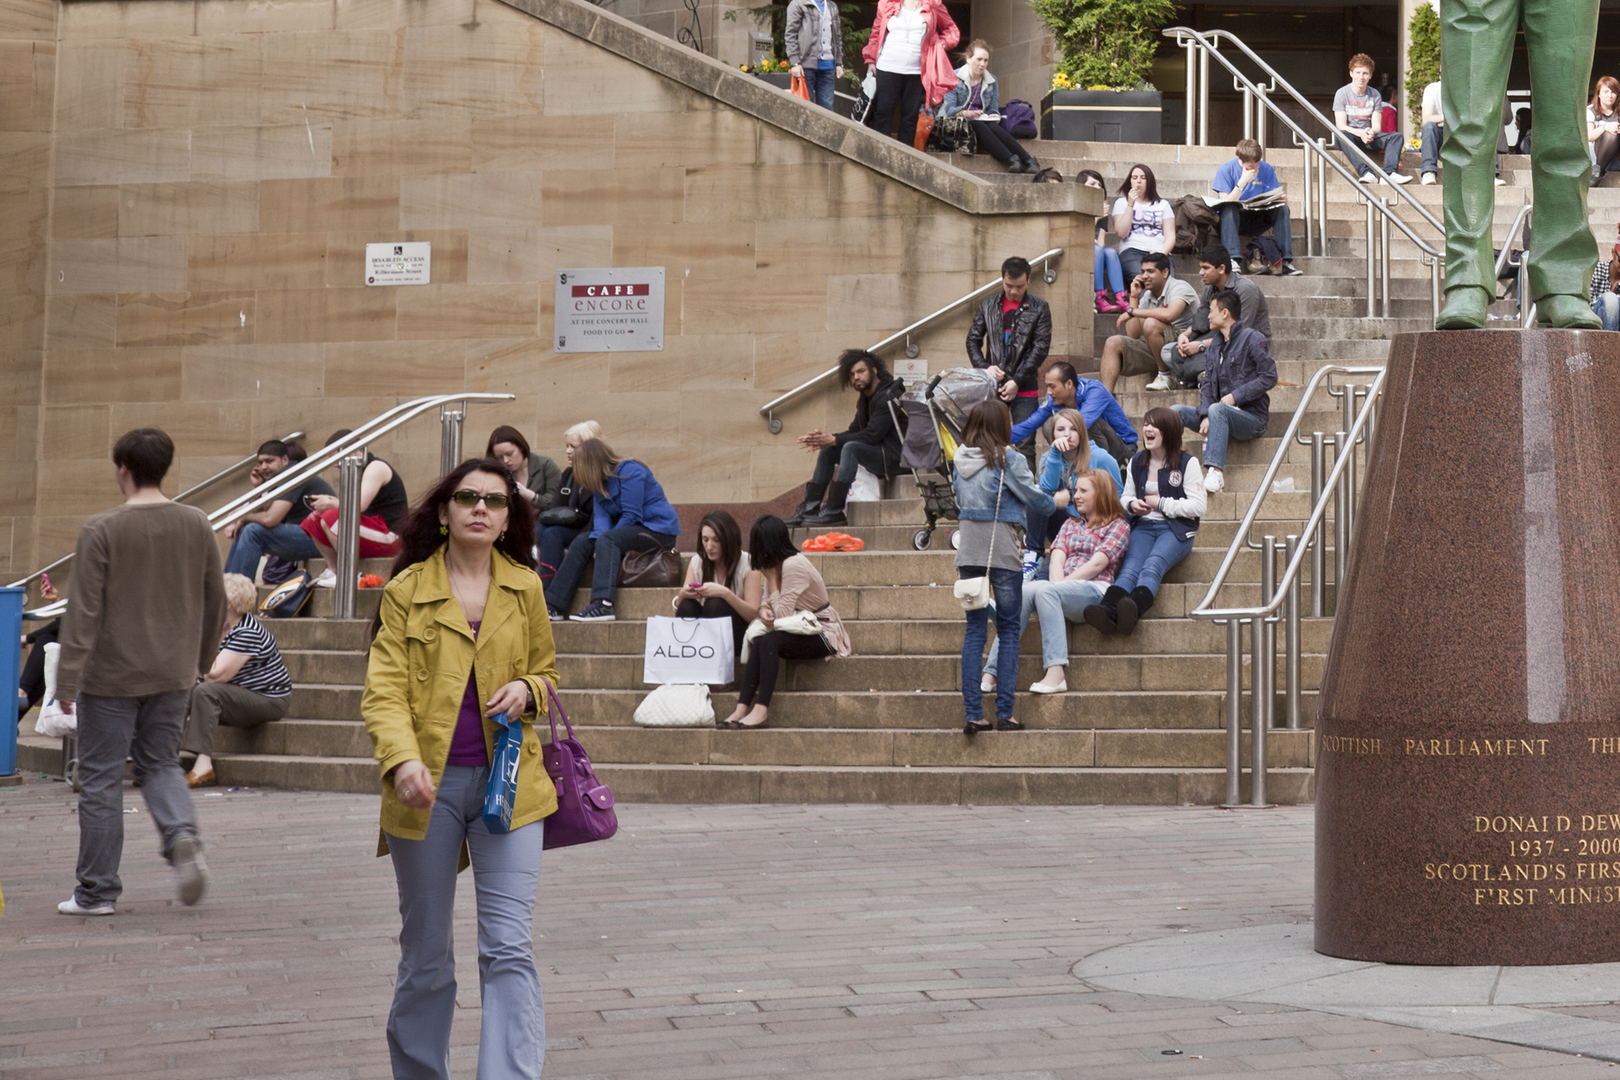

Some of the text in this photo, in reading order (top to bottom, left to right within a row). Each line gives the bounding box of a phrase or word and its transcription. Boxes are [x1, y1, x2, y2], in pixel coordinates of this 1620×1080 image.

[587, 285, 634, 296] CAFE
[653, 645, 715, 659] ALDO
[1322, 734, 1382, 755] SCOTTISH
[1405, 738, 1550, 756] PARLIAMENT
[1509, 839, 1555, 858] 1937
[1425, 862, 1567, 881] SCOTLAND'S
[1474, 887, 1538, 906] FIRST
